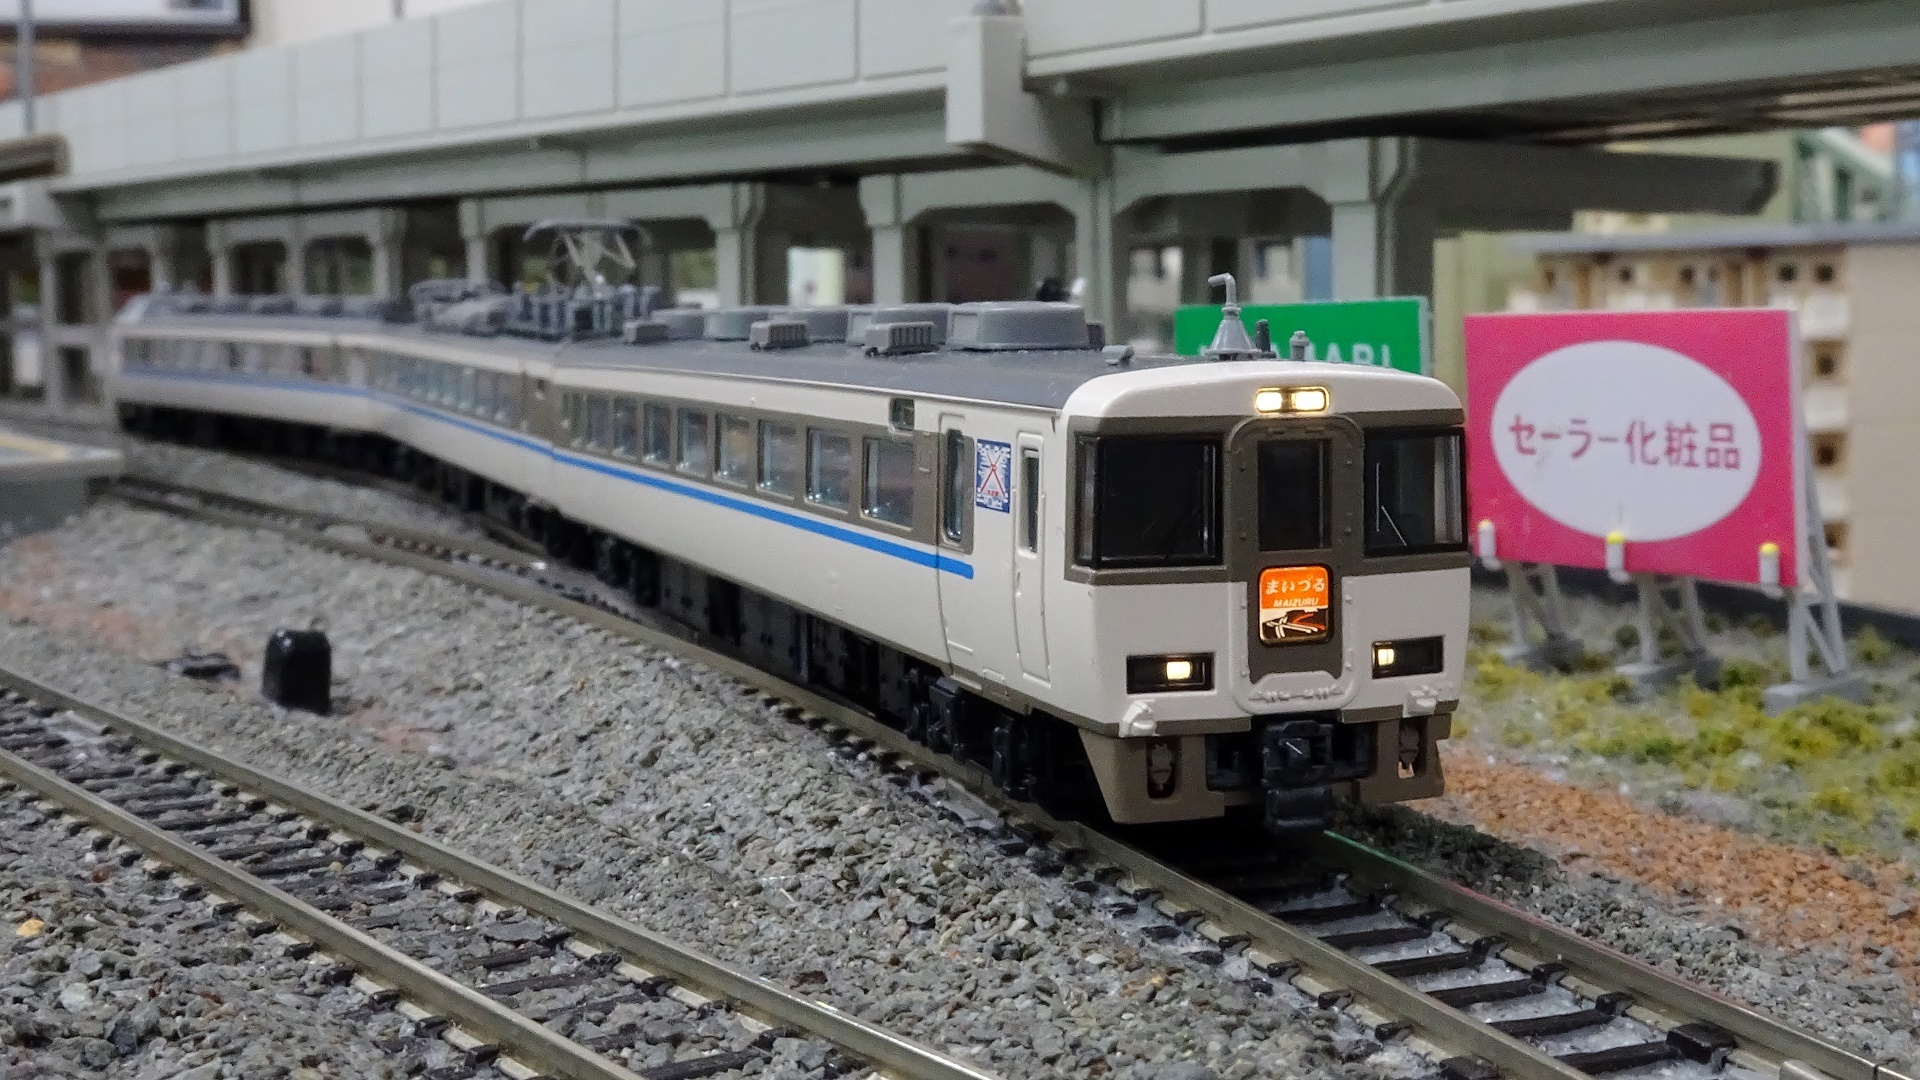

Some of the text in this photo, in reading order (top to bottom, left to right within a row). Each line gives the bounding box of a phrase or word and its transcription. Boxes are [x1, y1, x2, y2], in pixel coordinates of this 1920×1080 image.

[1508, 413, 1740, 469] セーラー化粧品
[1265, 576, 1325, 595] まいづる
[1273, 597, 1319, 607] MAIZURU
